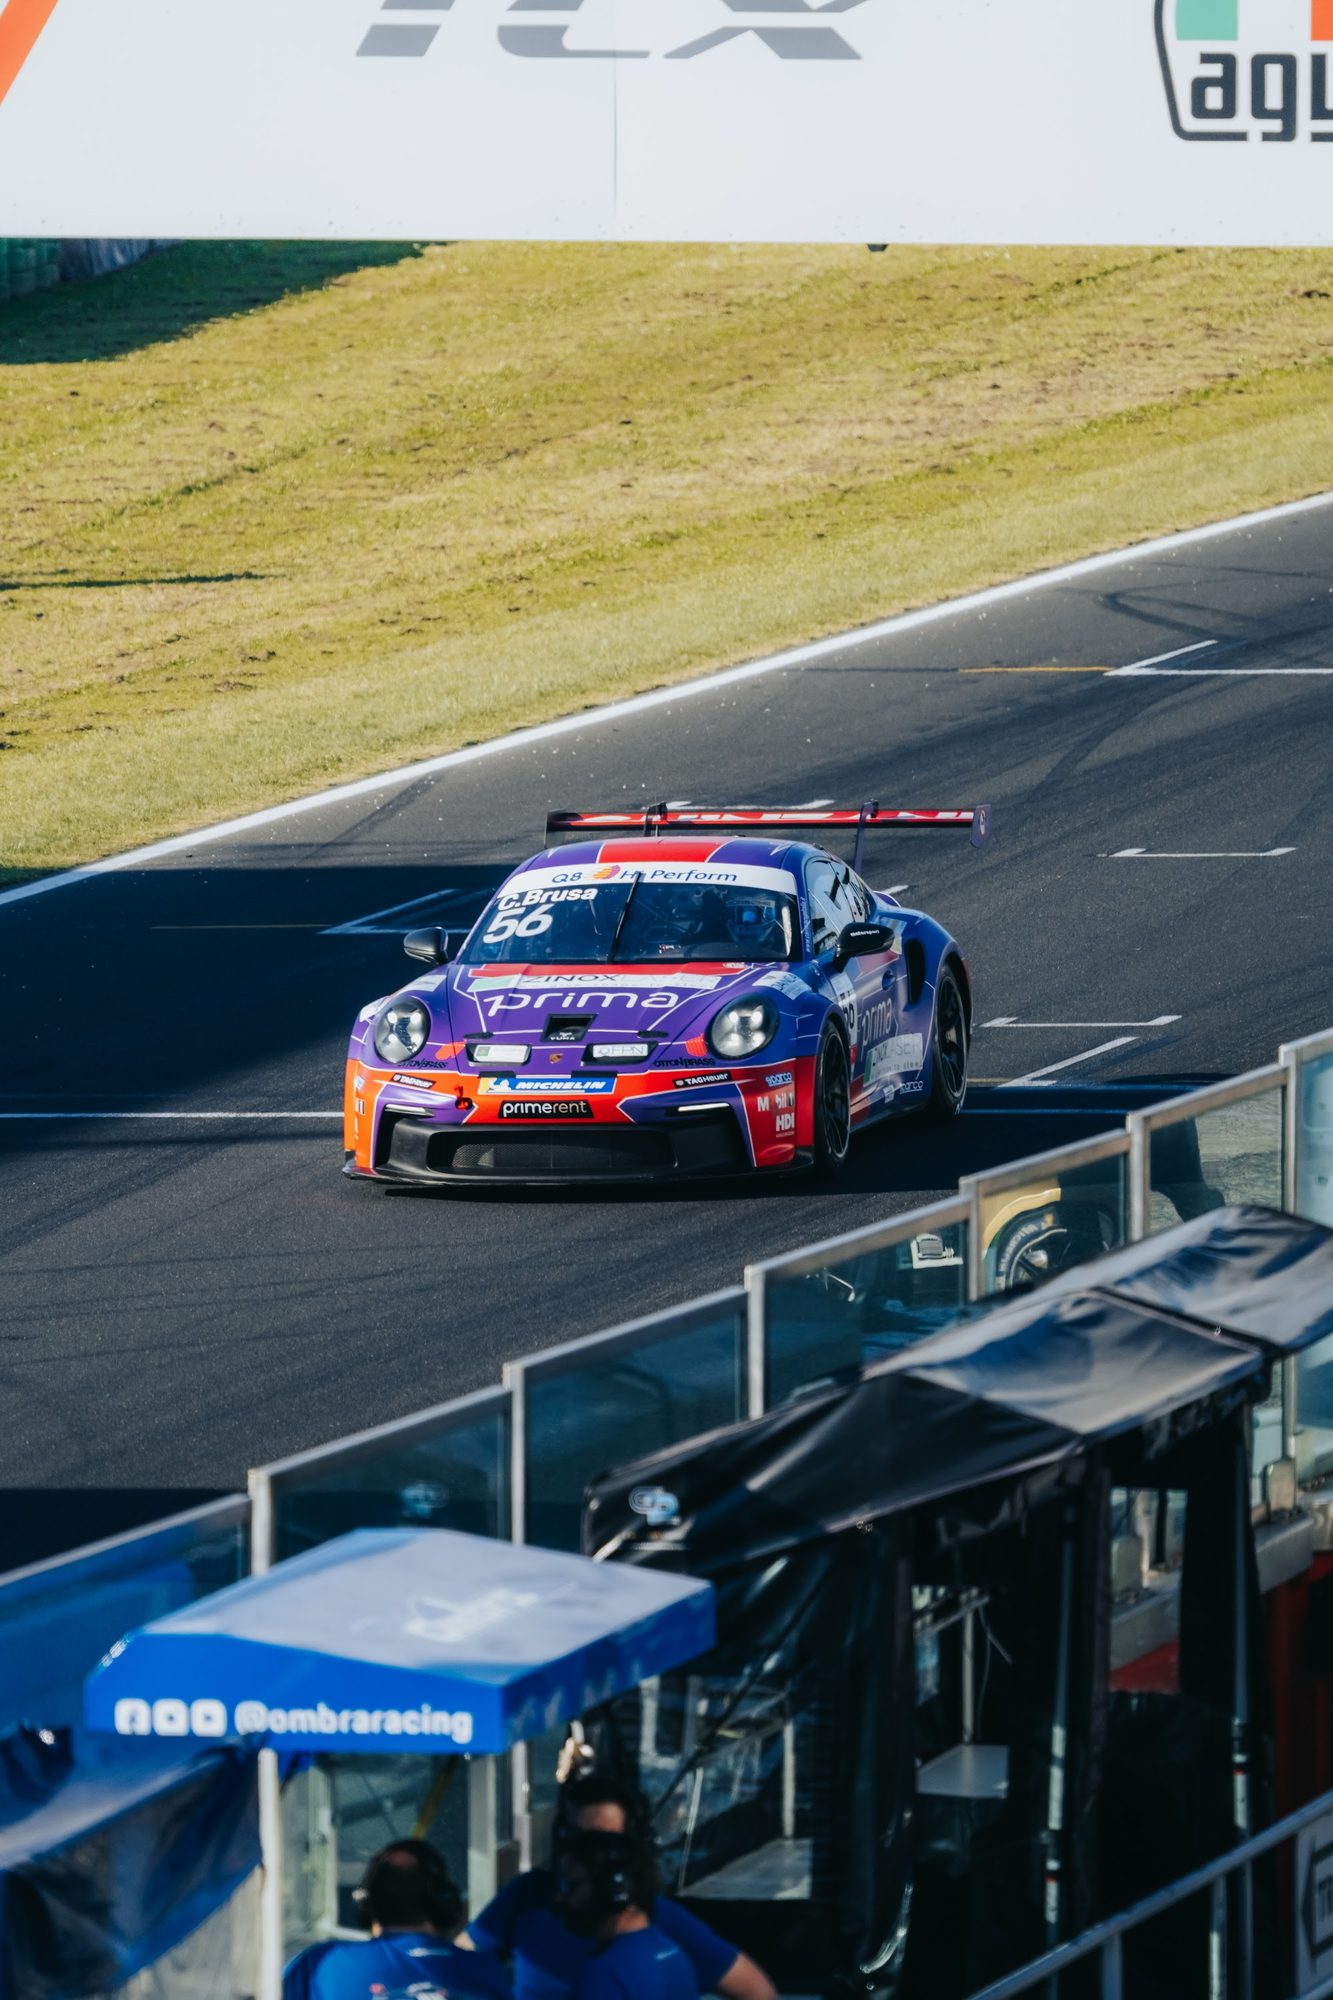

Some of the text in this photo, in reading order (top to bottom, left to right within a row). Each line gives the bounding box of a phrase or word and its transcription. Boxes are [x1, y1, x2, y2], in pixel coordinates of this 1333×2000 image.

[551, 869, 738, 884] Q8 H Perform
[497, 887, 598, 911] C.Brusa
[482, 904, 555, 944] 56
[483, 991, 679, 1017] prima
[861, 998, 892, 1061] prima
[516, 1081, 606, 1090] MICHELIN
[765, 1072, 792, 1087] sparco
[503, 1101, 588, 1118] primerent
[757, 1093, 787, 1112] Mbil
[776, 1112, 795, 1131] HDI
[235, 1701, 473, 1744] @ombraracing
